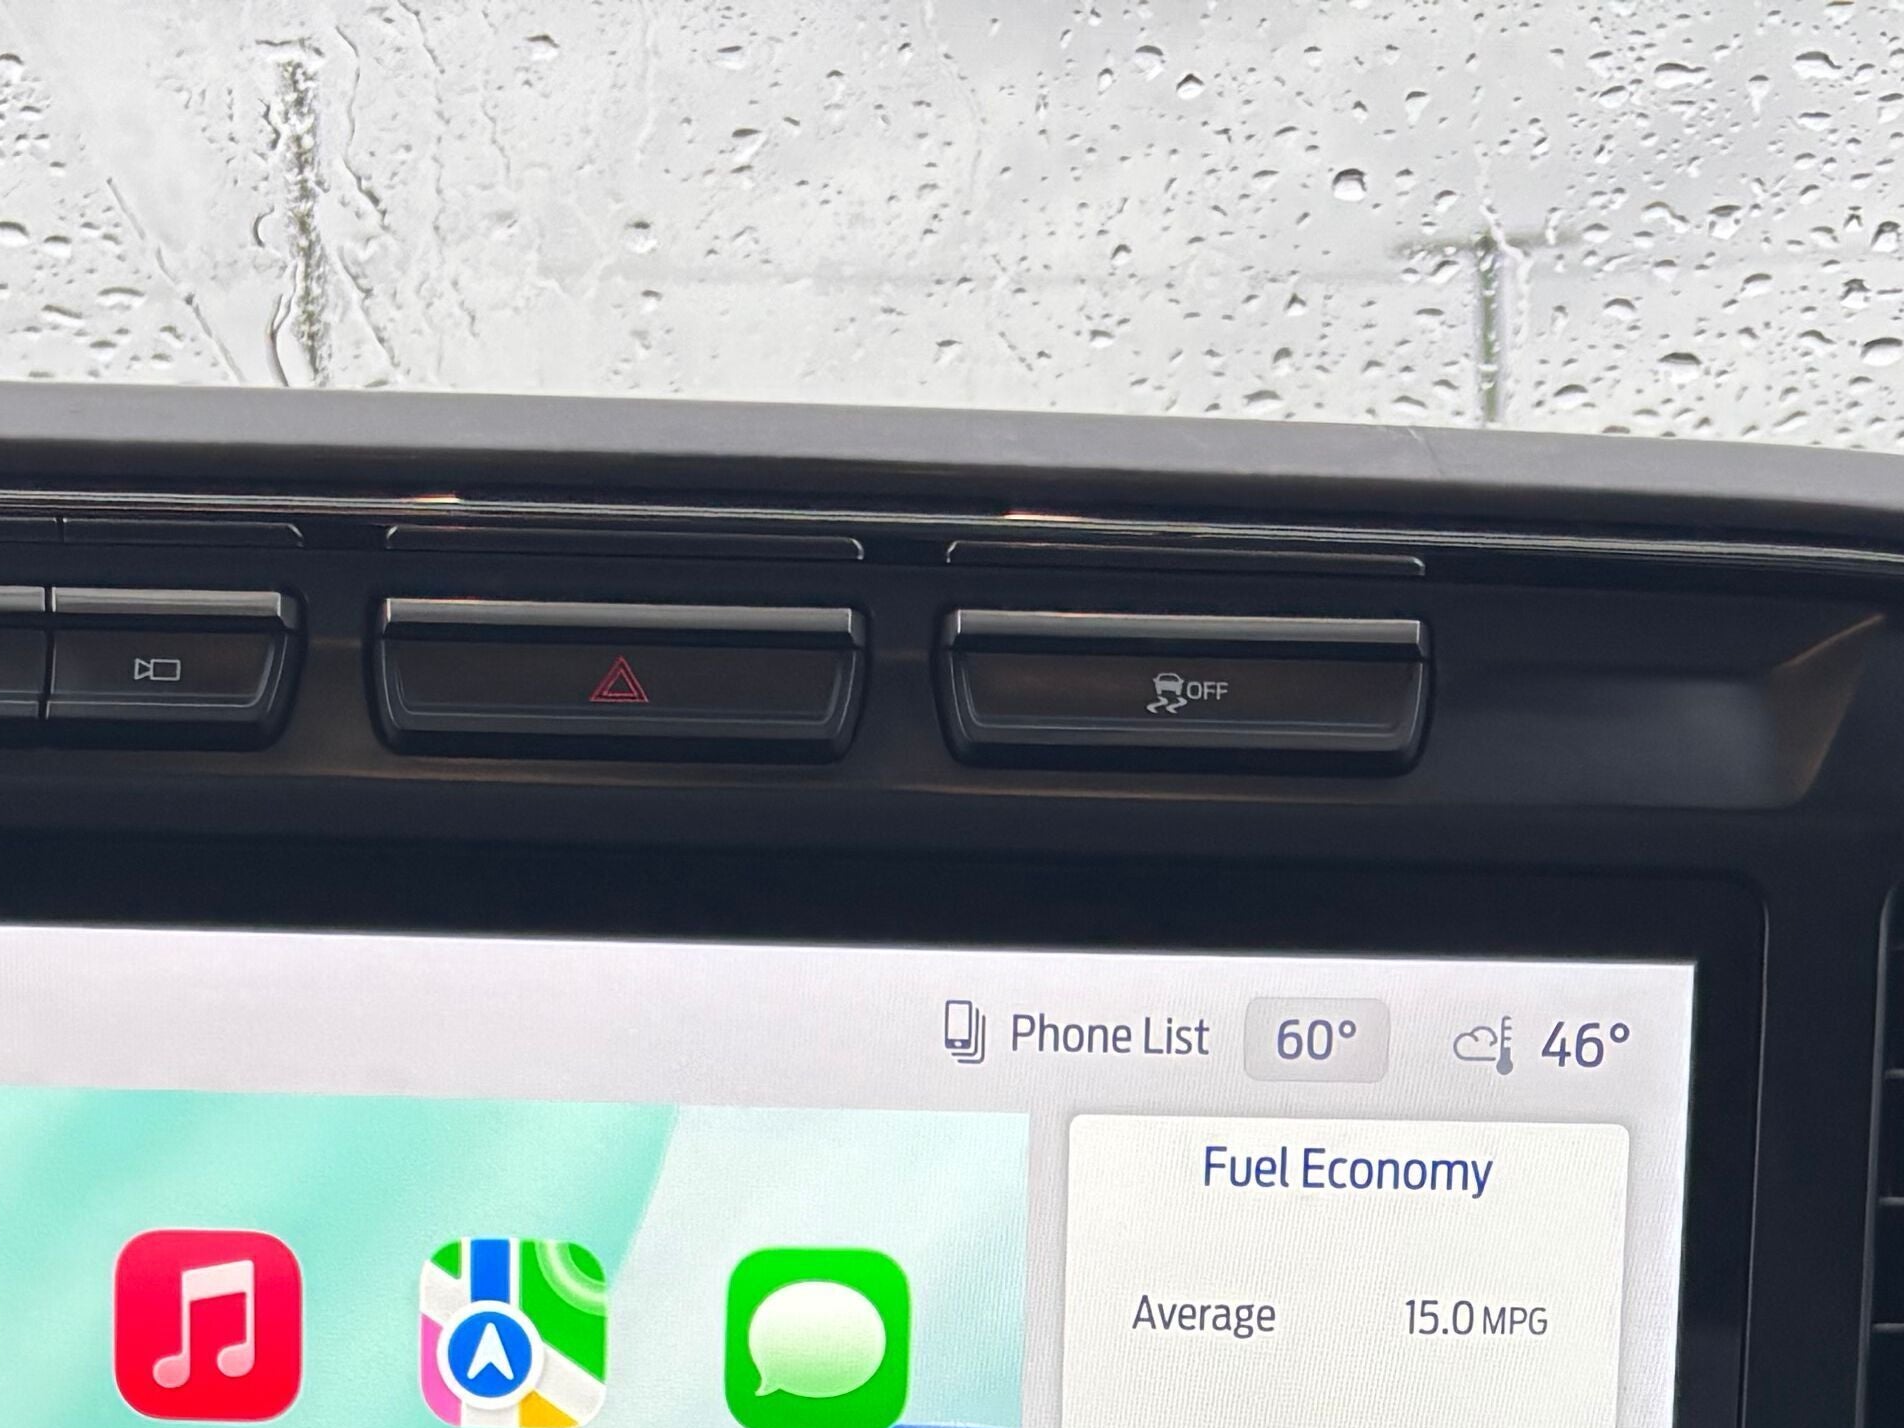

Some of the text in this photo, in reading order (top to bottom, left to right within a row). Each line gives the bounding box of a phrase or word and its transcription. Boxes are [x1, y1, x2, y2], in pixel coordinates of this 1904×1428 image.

[1186, 681, 1229, 701] OFF
[1011, 1014, 1211, 1056] Phone List
[1276, 1018, 1358, 1062] 60°
[1541, 1021, 1631, 1068] 46°
[1203, 1146, 1494, 1199] Fuel Economy
[1131, 1295, 1277, 1339] Average
[1405, 1299, 1549, 1337] 15.0 MPG
